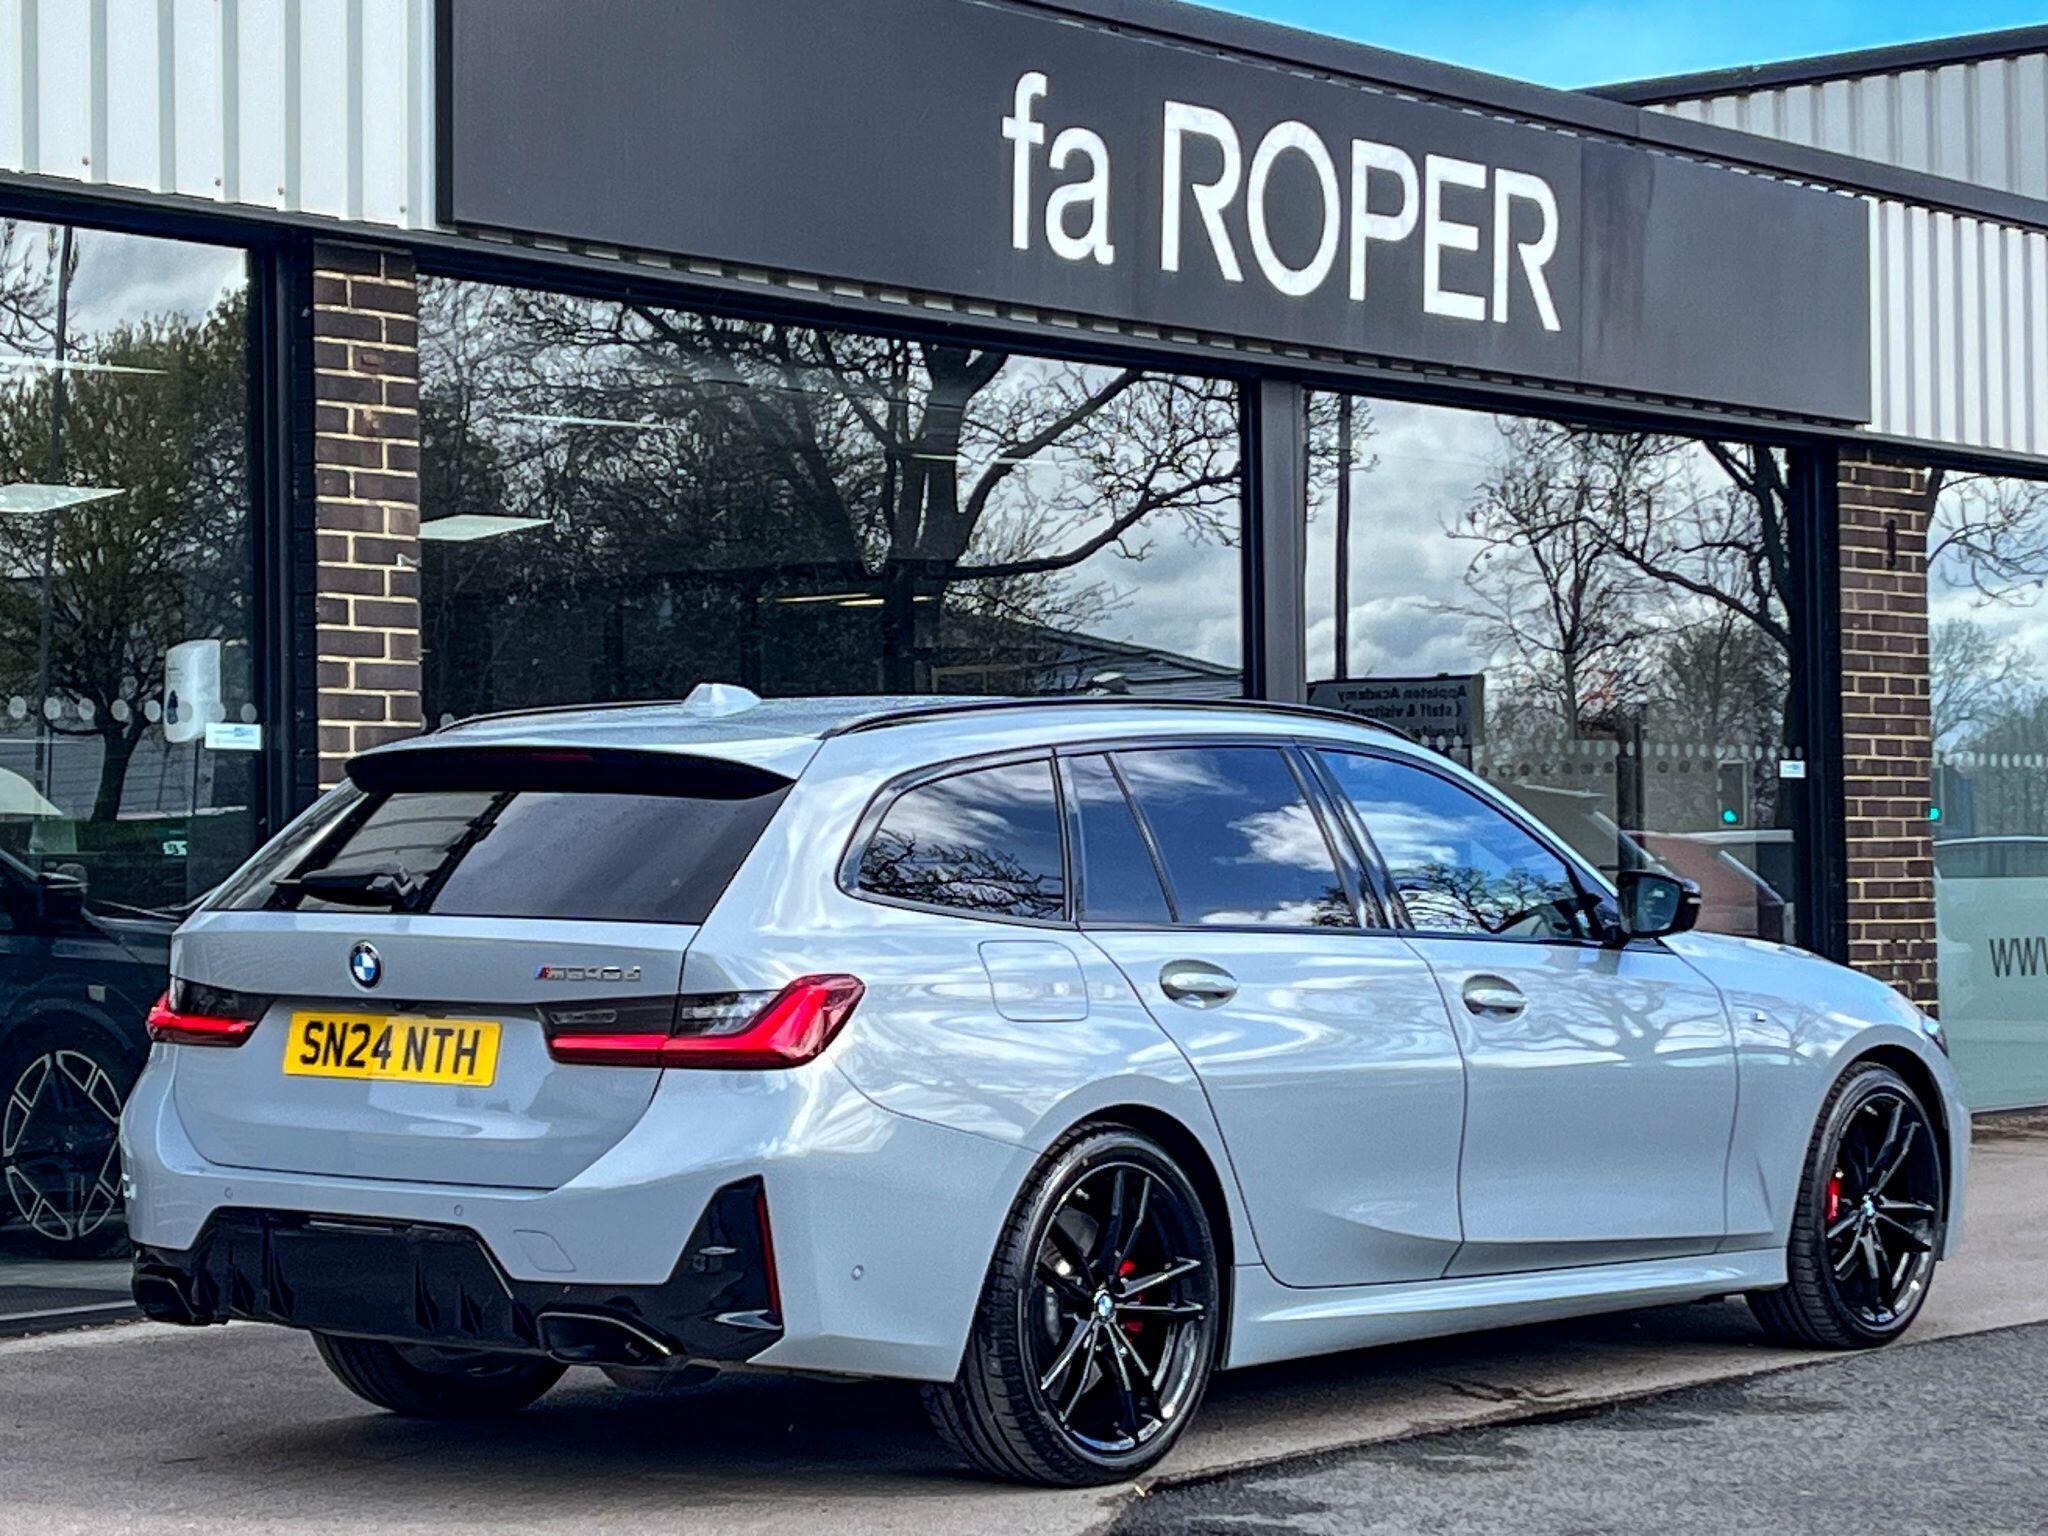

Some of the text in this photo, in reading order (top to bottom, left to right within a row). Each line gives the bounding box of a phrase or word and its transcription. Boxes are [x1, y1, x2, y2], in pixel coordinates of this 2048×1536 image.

[1002, 71, 1561, 332] fa ROPER
[300, 1020, 481, 1076] SN24 NTH
